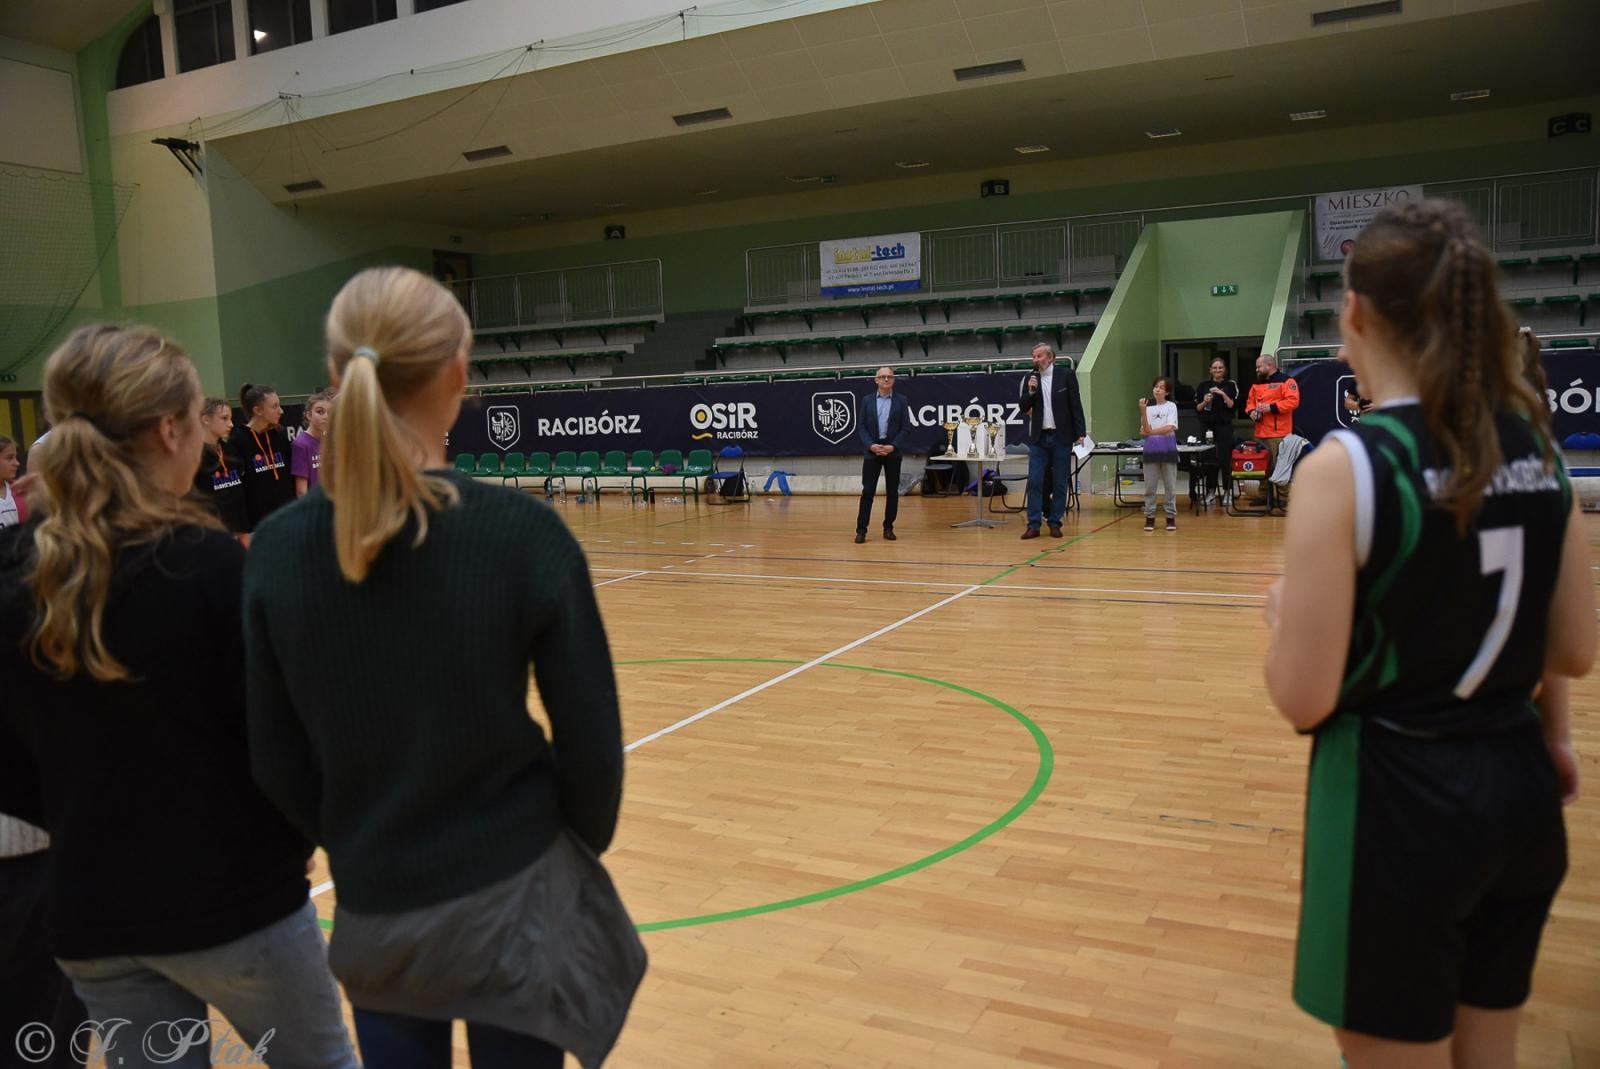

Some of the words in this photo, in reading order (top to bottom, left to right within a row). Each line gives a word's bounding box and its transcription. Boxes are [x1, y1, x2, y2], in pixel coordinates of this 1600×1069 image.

[994, 185, 1005, 194] B
[610, 230, 622, 239] A
[537, 409, 642, 437] RACIBÓRZ
[690, 402, 758, 430] OSiR
[906, 396, 1024, 427] CIBÓRZ
[716, 430, 759, 440] RACIBÓRZ
[1453, 525, 1525, 700] 7
